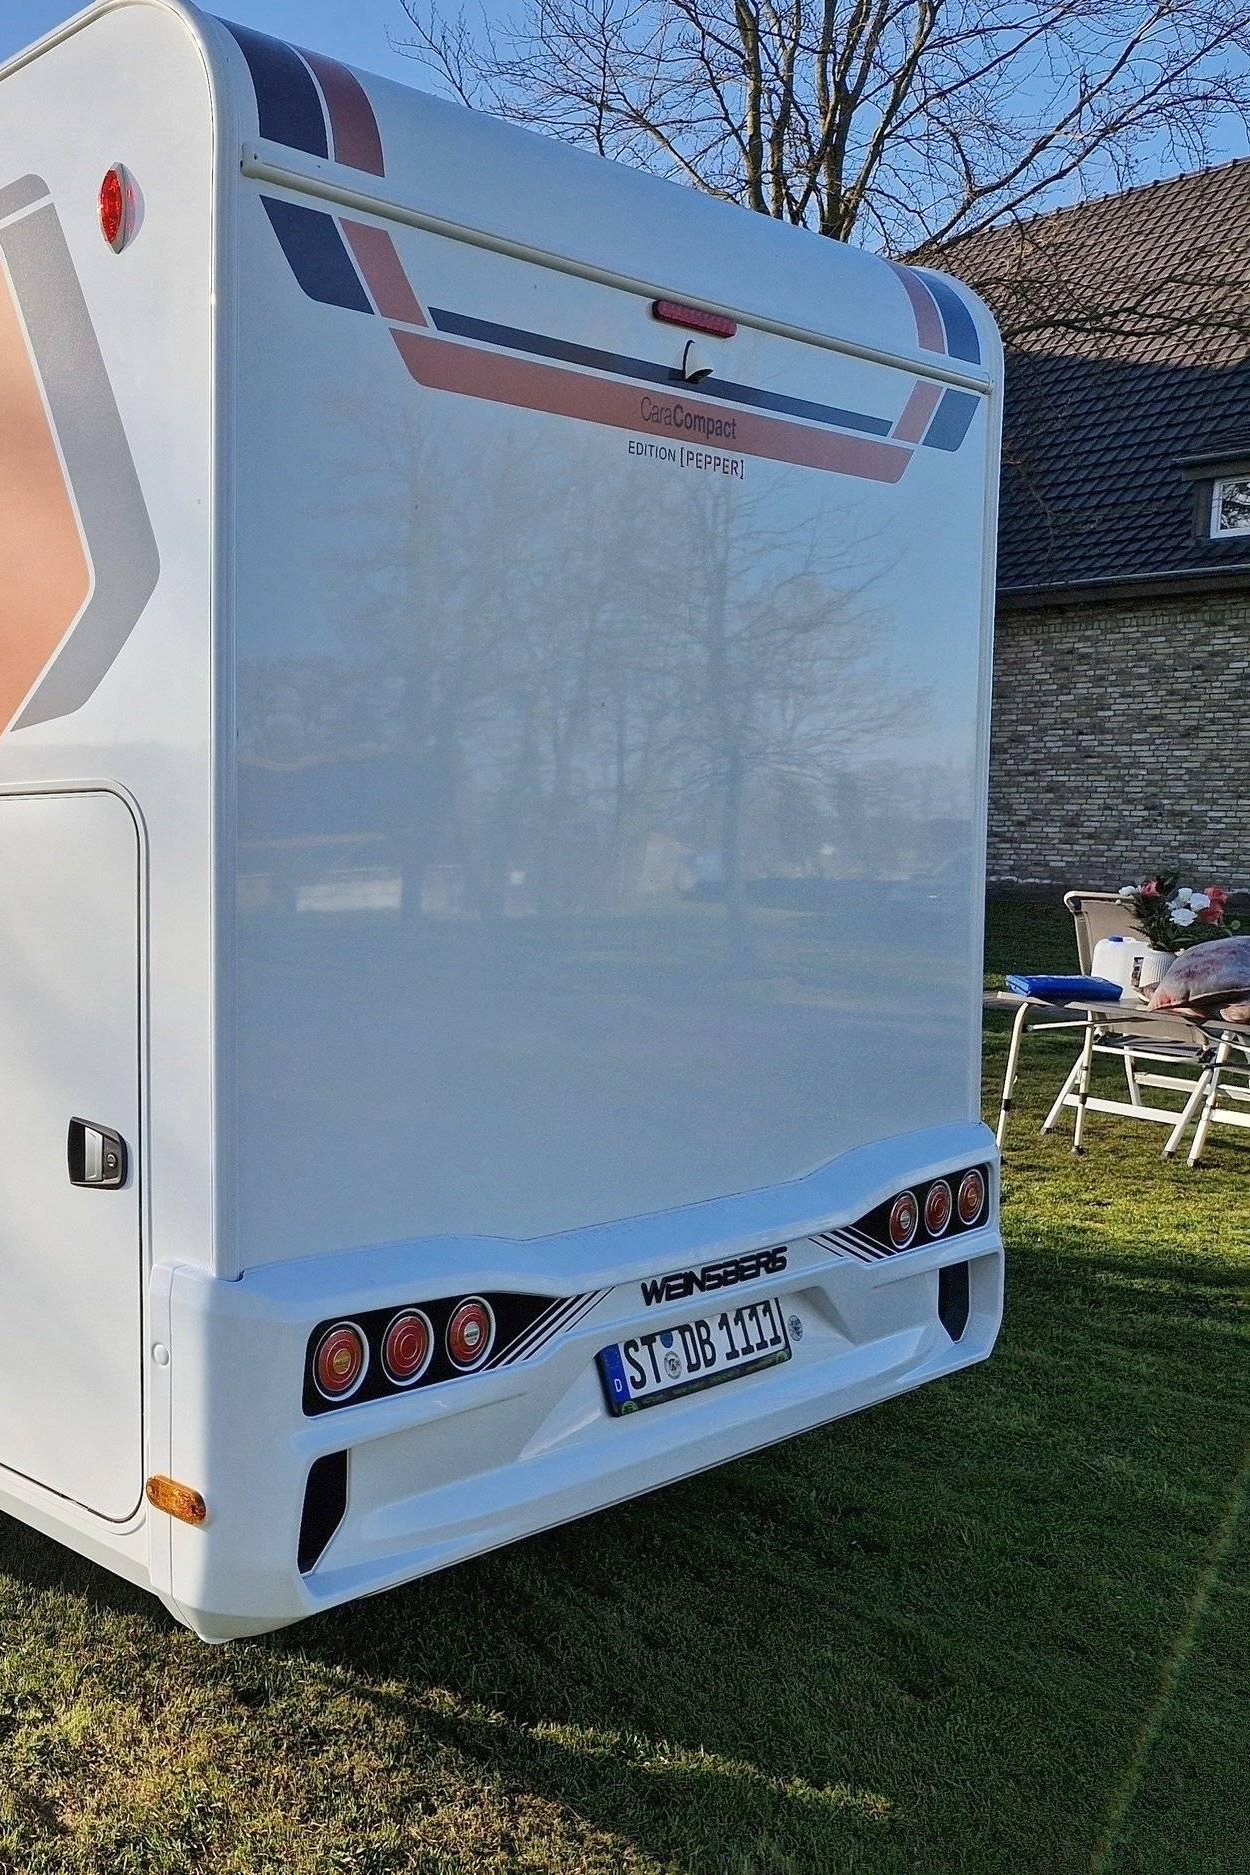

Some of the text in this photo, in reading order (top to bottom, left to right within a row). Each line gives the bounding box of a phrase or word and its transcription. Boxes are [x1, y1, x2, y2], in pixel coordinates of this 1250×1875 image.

[640, 396, 737, 440] CaraCompact
[628, 440, 744, 479] EDITION [PEPPER]
[640, 1246, 788, 1307] WEINSBERG
[623, 1334, 661, 1390] ST
[678, 1319, 717, 1374] DB
[718, 1300, 782, 1361] 1111
[614, 1377, 623, 1393] D
